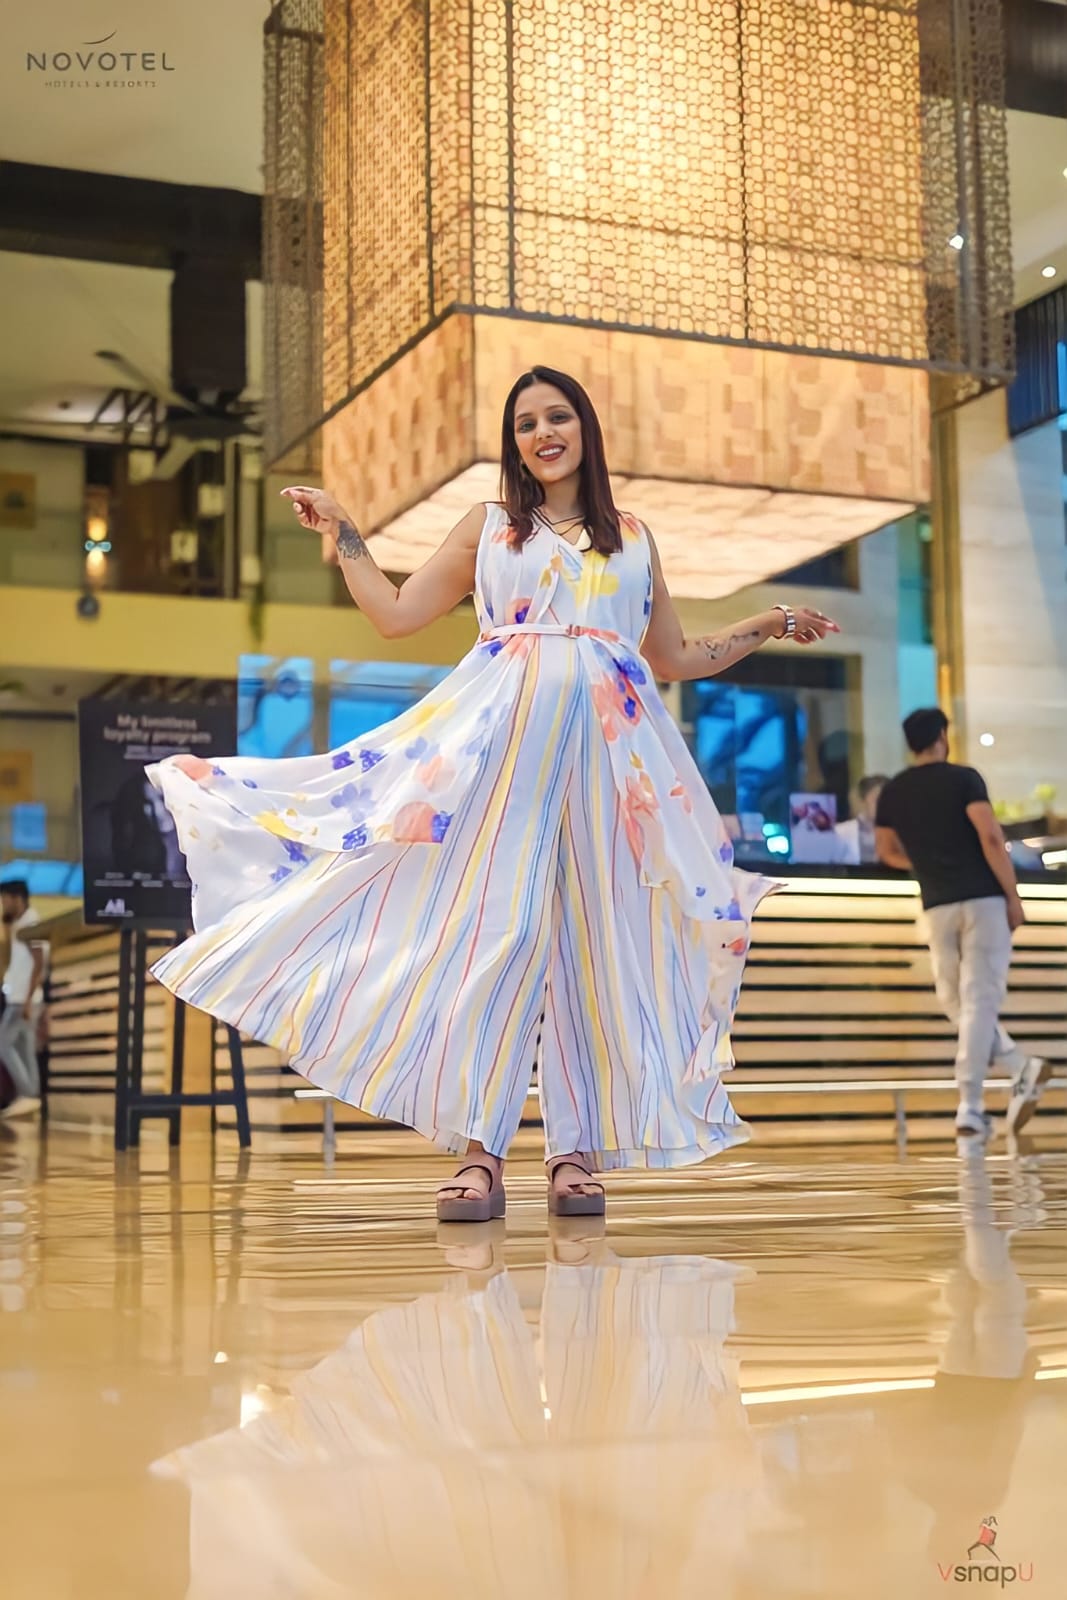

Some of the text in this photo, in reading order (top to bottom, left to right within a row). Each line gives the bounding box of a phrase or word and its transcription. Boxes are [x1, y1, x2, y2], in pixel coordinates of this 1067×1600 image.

[117, 714, 138, 730] My
[103, 726, 212, 744] loyalty program
